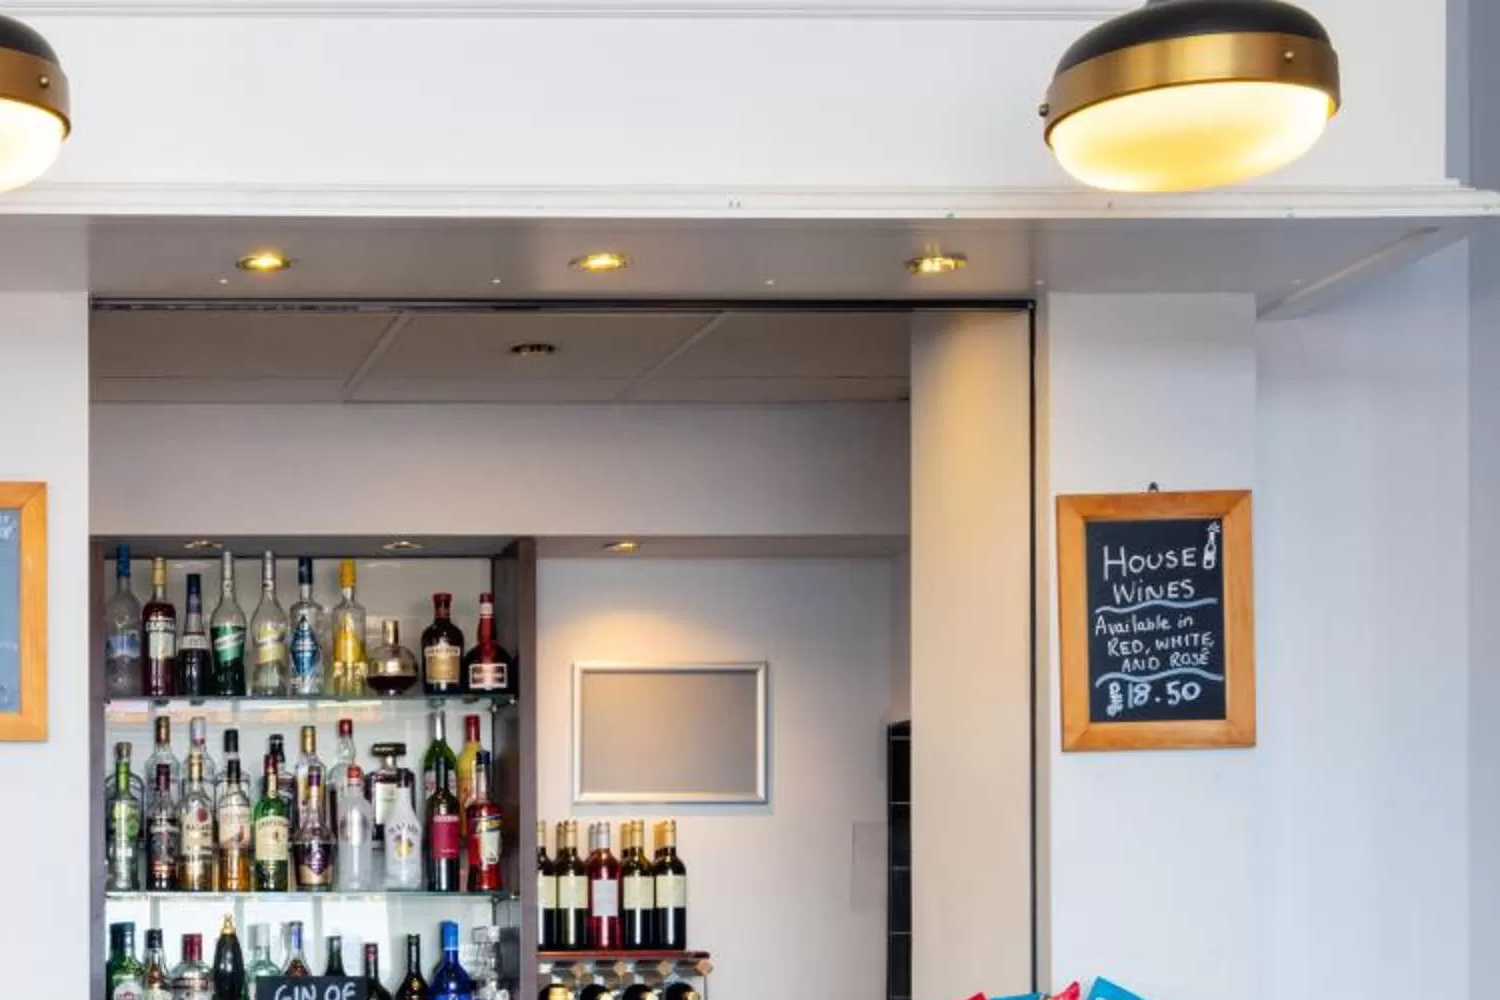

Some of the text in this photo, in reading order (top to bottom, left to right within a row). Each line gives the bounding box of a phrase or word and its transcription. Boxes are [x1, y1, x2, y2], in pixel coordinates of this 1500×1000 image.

[1103, 544, 1197, 580] HOUSE
[1095, 614, 1194, 636] Available in
[1122, 656, 1160, 673] AND
[1106, 681, 1202, 717] £18.50
